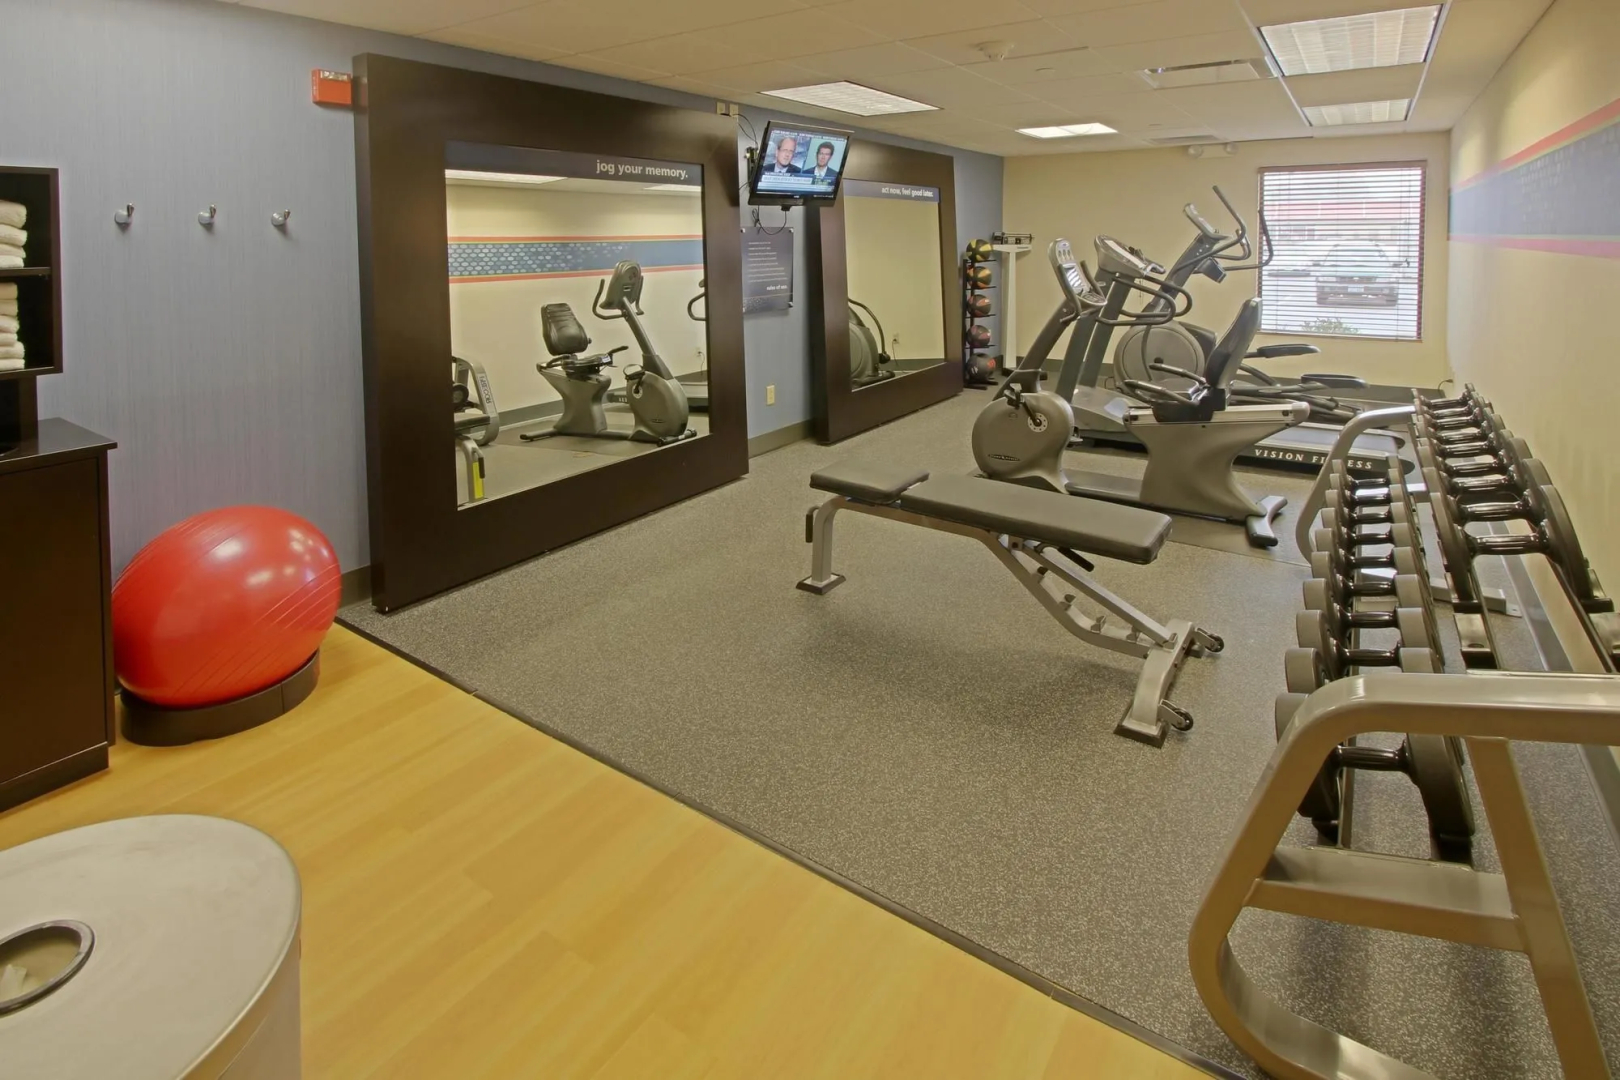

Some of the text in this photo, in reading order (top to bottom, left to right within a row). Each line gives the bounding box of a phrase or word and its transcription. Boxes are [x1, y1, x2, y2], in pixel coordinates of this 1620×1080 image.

[596, 160, 688, 180] jog your memory.
[911, 189, 923, 198] good
[1254, 449, 1373, 469] VISION FIESS
